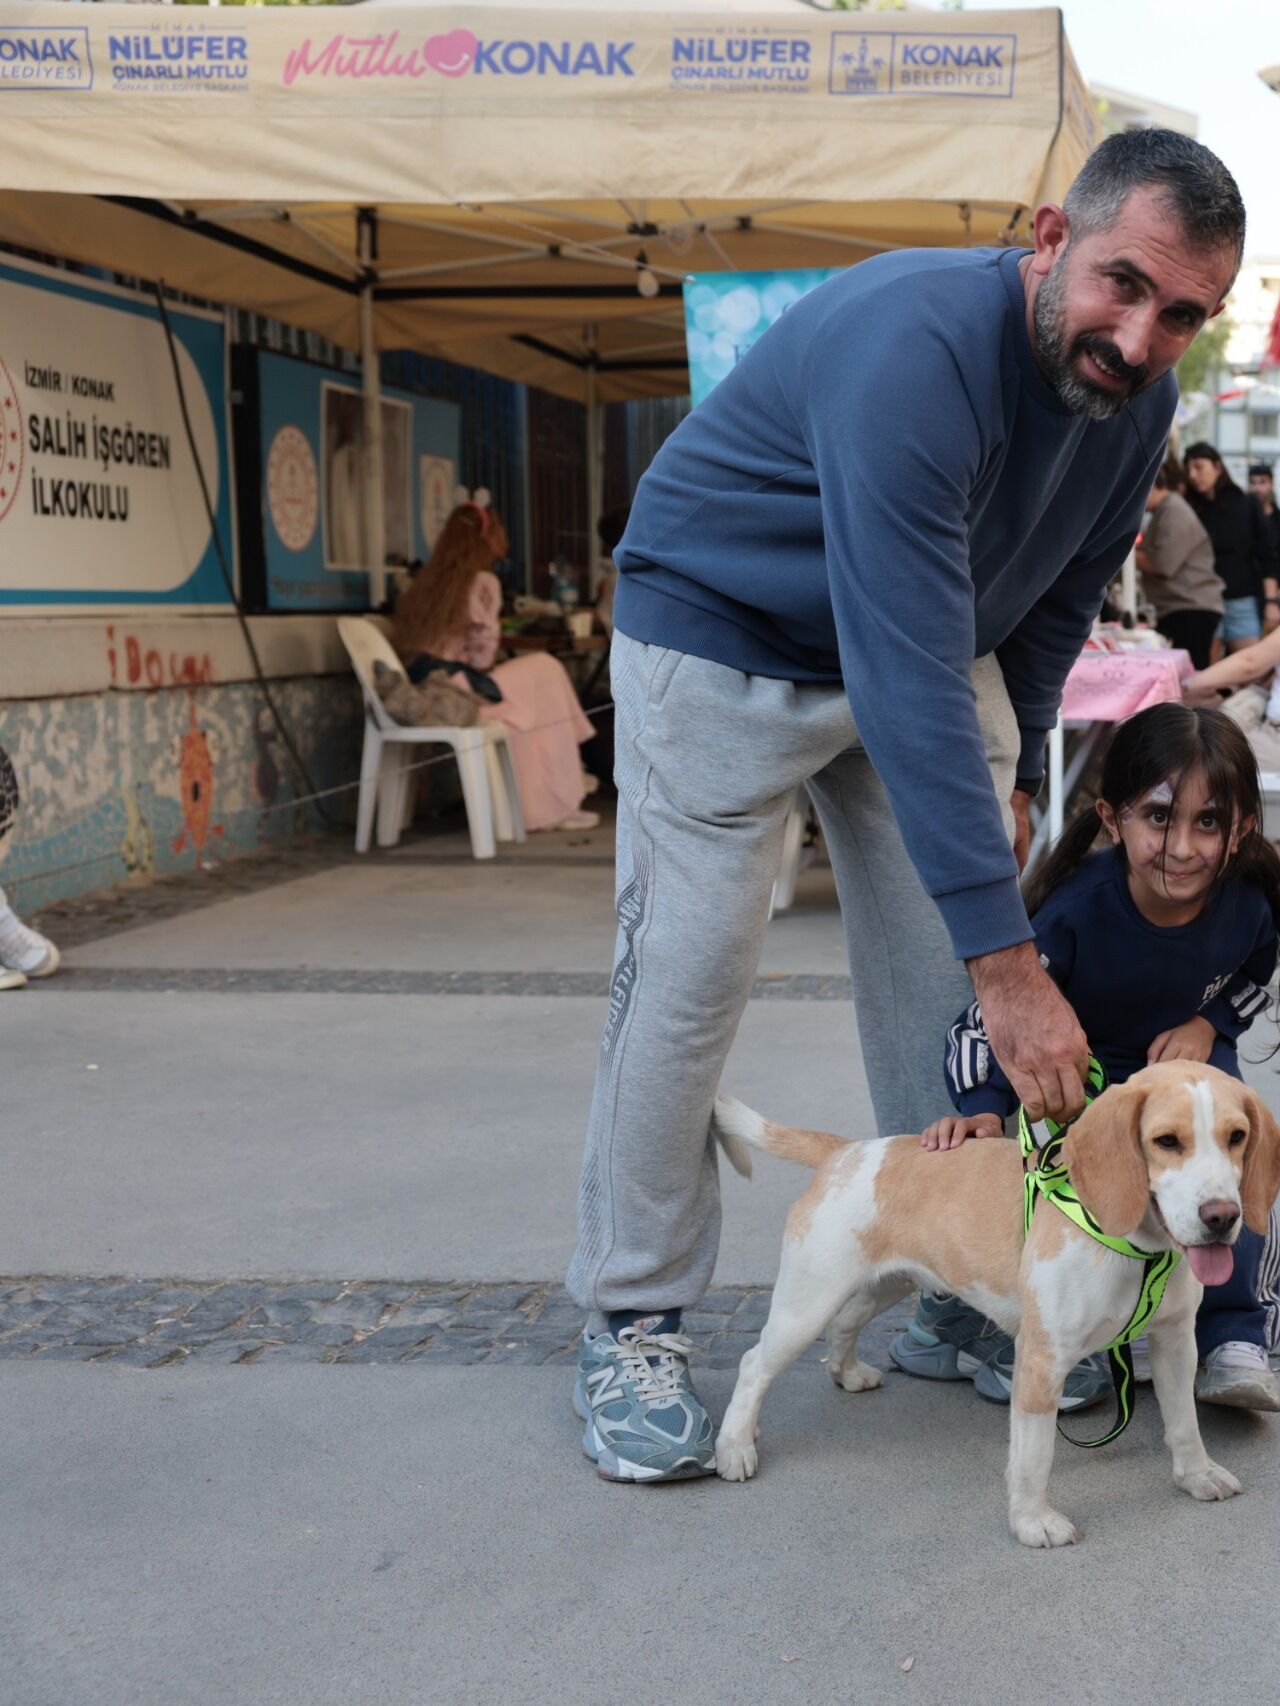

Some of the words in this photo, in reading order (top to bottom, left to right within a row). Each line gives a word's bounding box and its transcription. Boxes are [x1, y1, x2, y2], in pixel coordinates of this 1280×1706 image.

[0, 38, 79, 62] ONAK
[282, 29, 428, 86] Mutlu
[474, 40, 635, 77] KONAK
[902, 44, 1004, 68] KONAK
[1, 62, 83, 80] LEDİYESİ
[187, 66, 248, 79] MUTLU
[748, 67, 810, 81] MUTLU
[25, 360, 62, 393] İZMİR
[71, 374, 115, 402] KONAK
[28, 410, 87, 459] SALİH
[92, 415, 171, 473] İŞGÖREN
[31, 467, 129, 522] İLKOKULU
